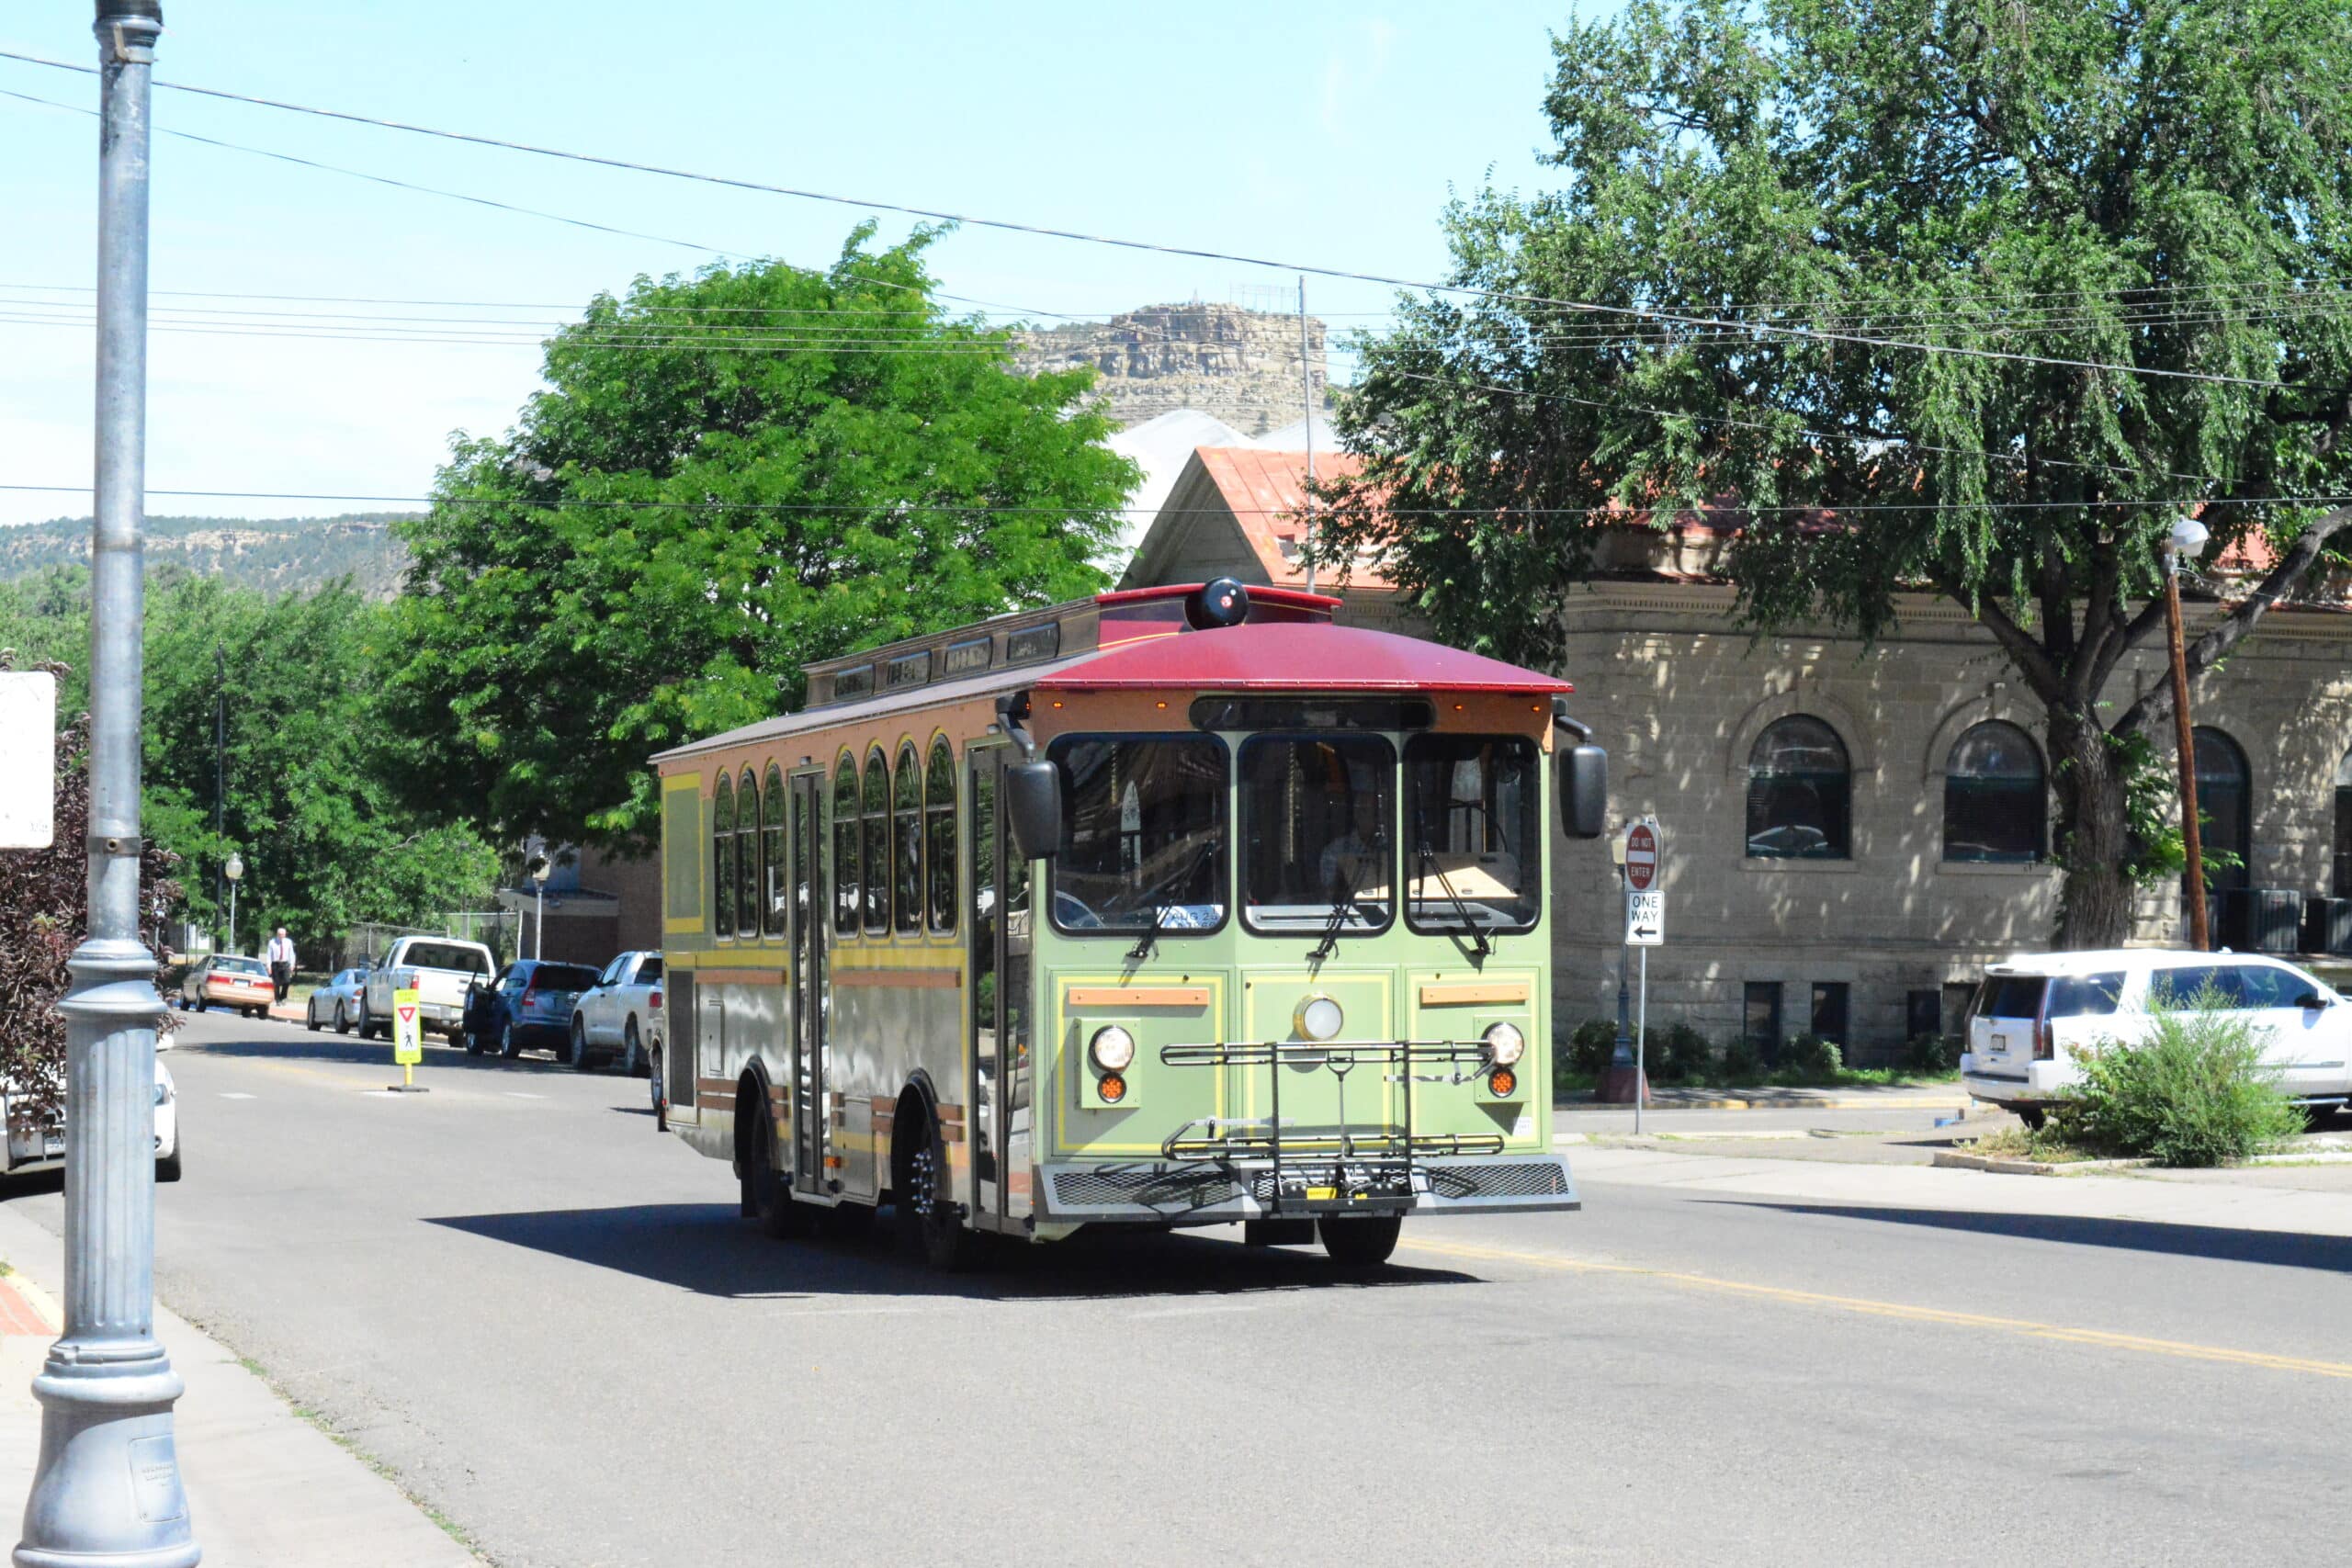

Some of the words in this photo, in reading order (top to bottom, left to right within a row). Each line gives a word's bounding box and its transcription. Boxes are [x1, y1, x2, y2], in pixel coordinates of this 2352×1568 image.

[1631, 837, 1639, 847] DO
[1641, 837, 1652, 848] NOT
[1631, 866, 1651, 877] ENTER
[1633, 896, 1658, 908] ONE
[1631, 910, 1658, 922] WAY
